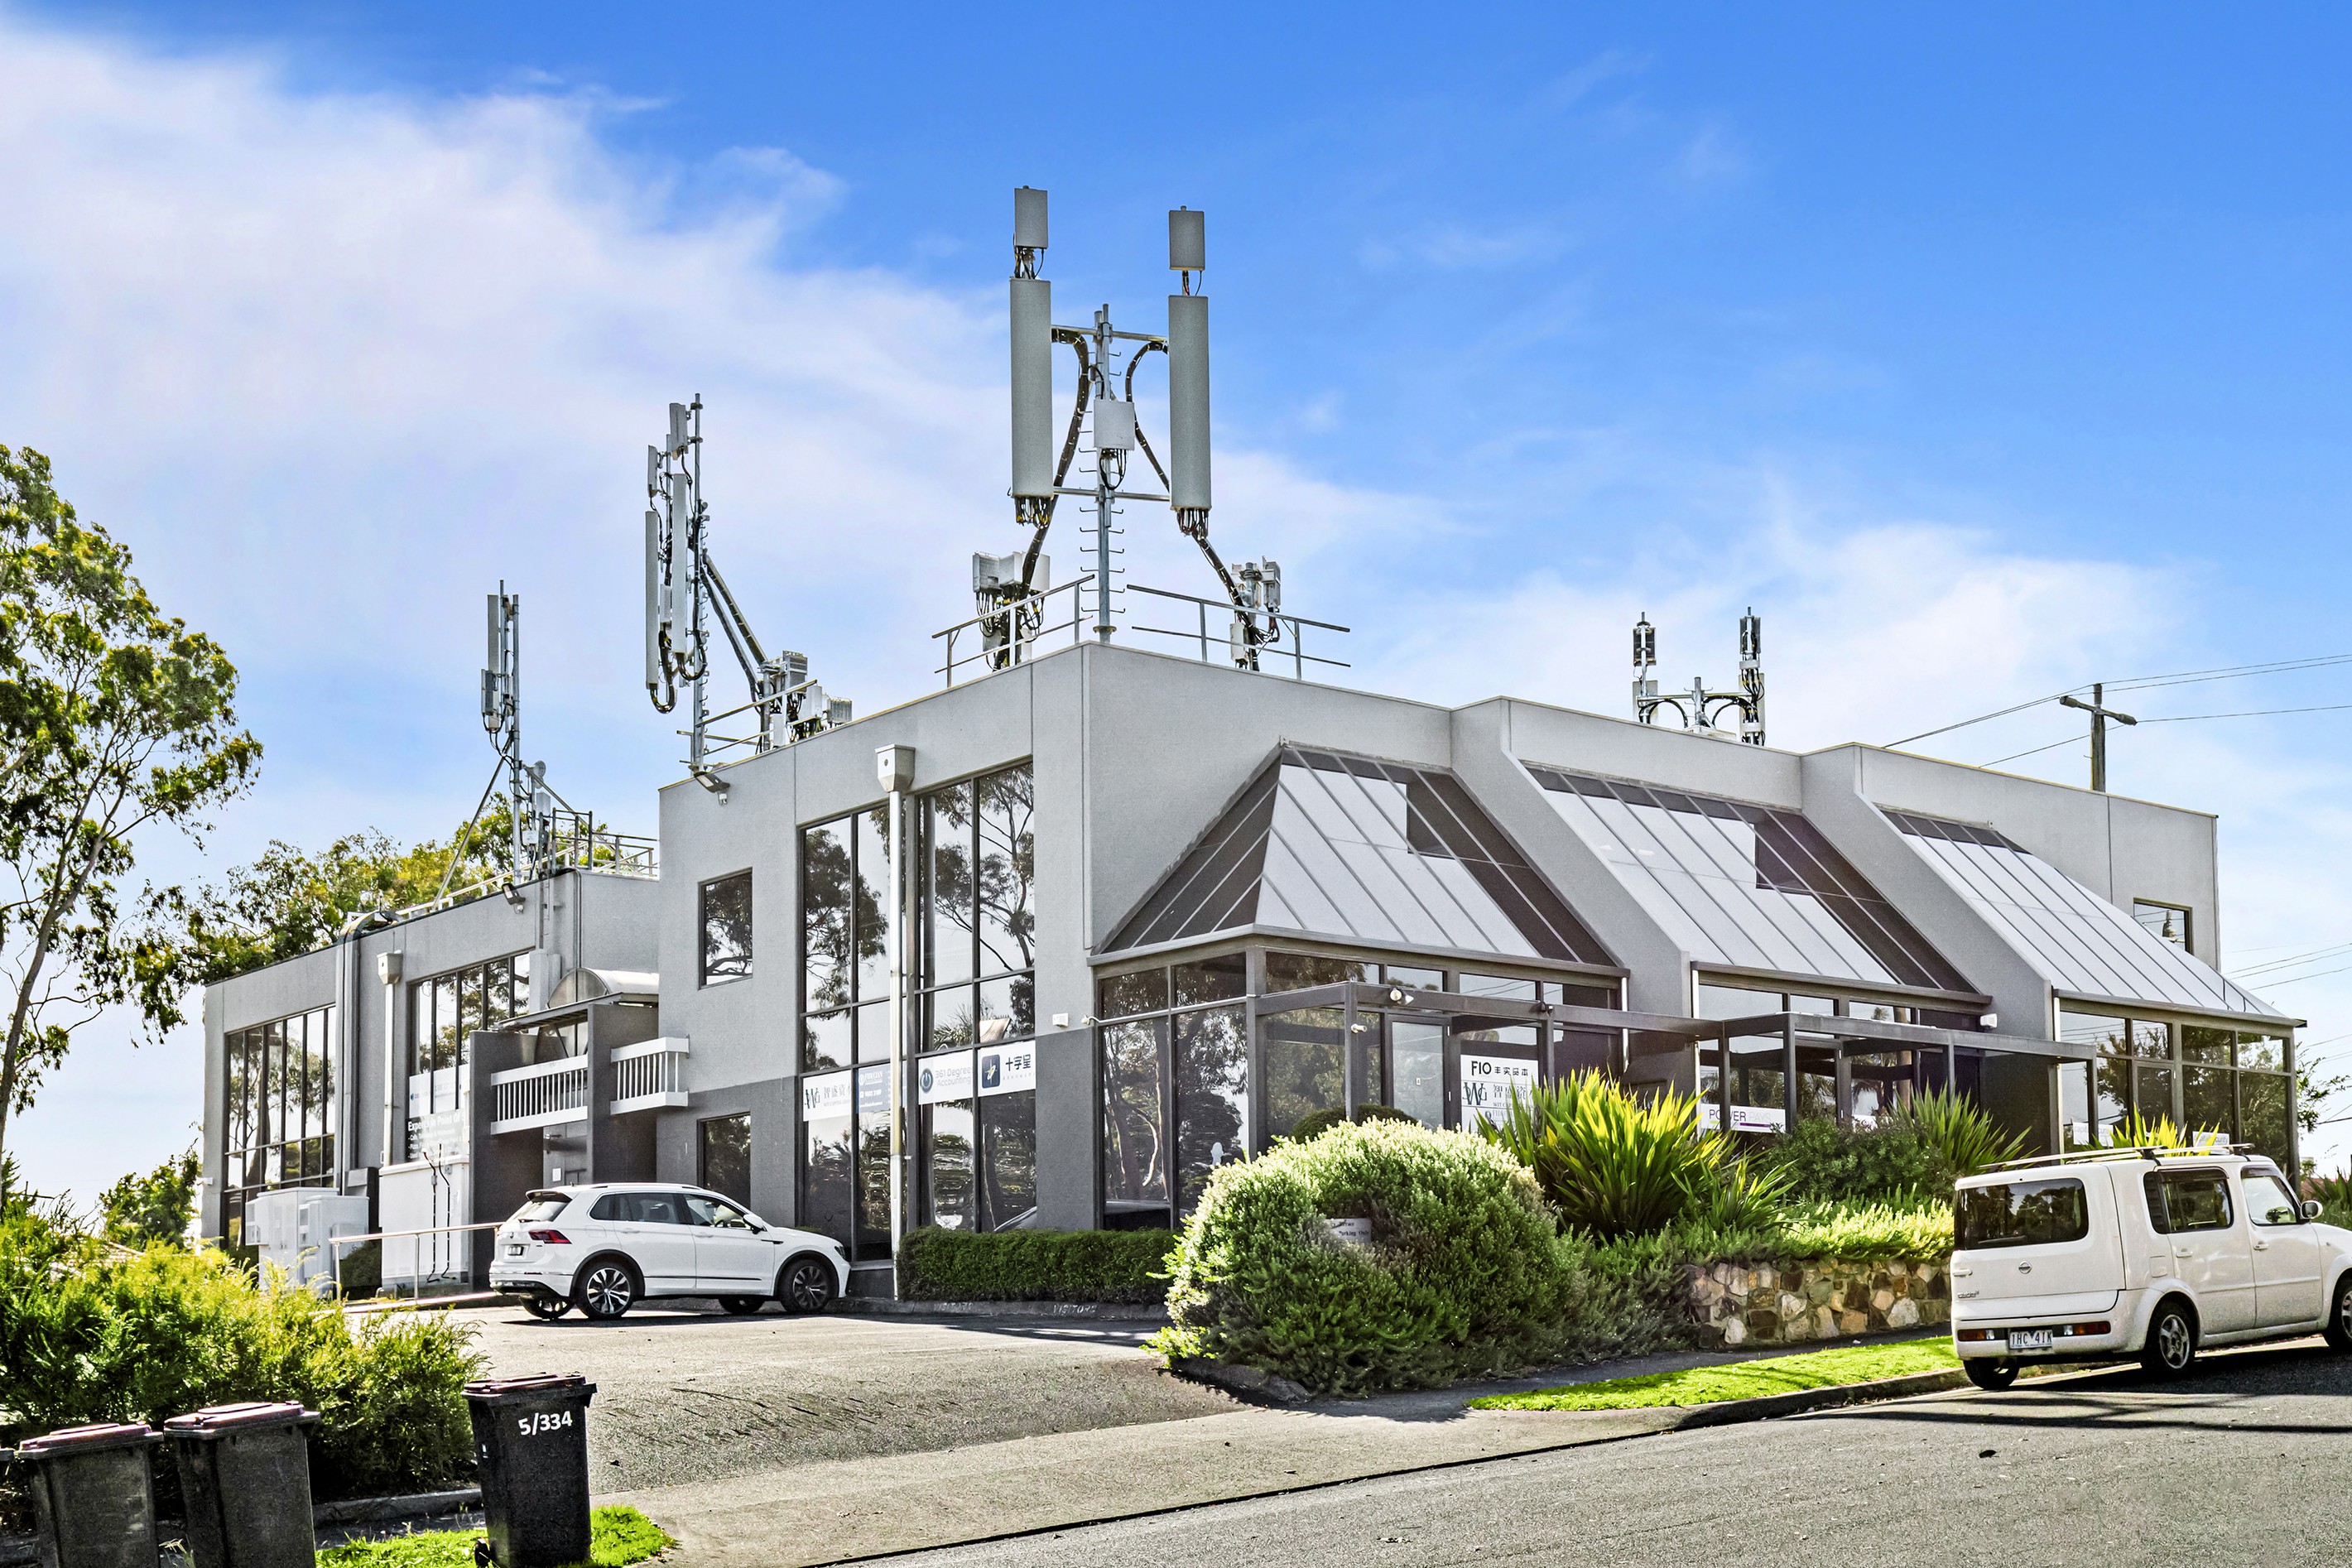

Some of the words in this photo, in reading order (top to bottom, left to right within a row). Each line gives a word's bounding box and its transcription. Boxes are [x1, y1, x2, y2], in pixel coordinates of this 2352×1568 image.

[935, 1070, 945, 1079] 361
[947, 1067, 973, 1078] Degree
[1471, 1061, 1492, 1076] FIO
[936, 1076, 971, 1086] Accounting
[517, 1411, 573, 1436] 5/334
